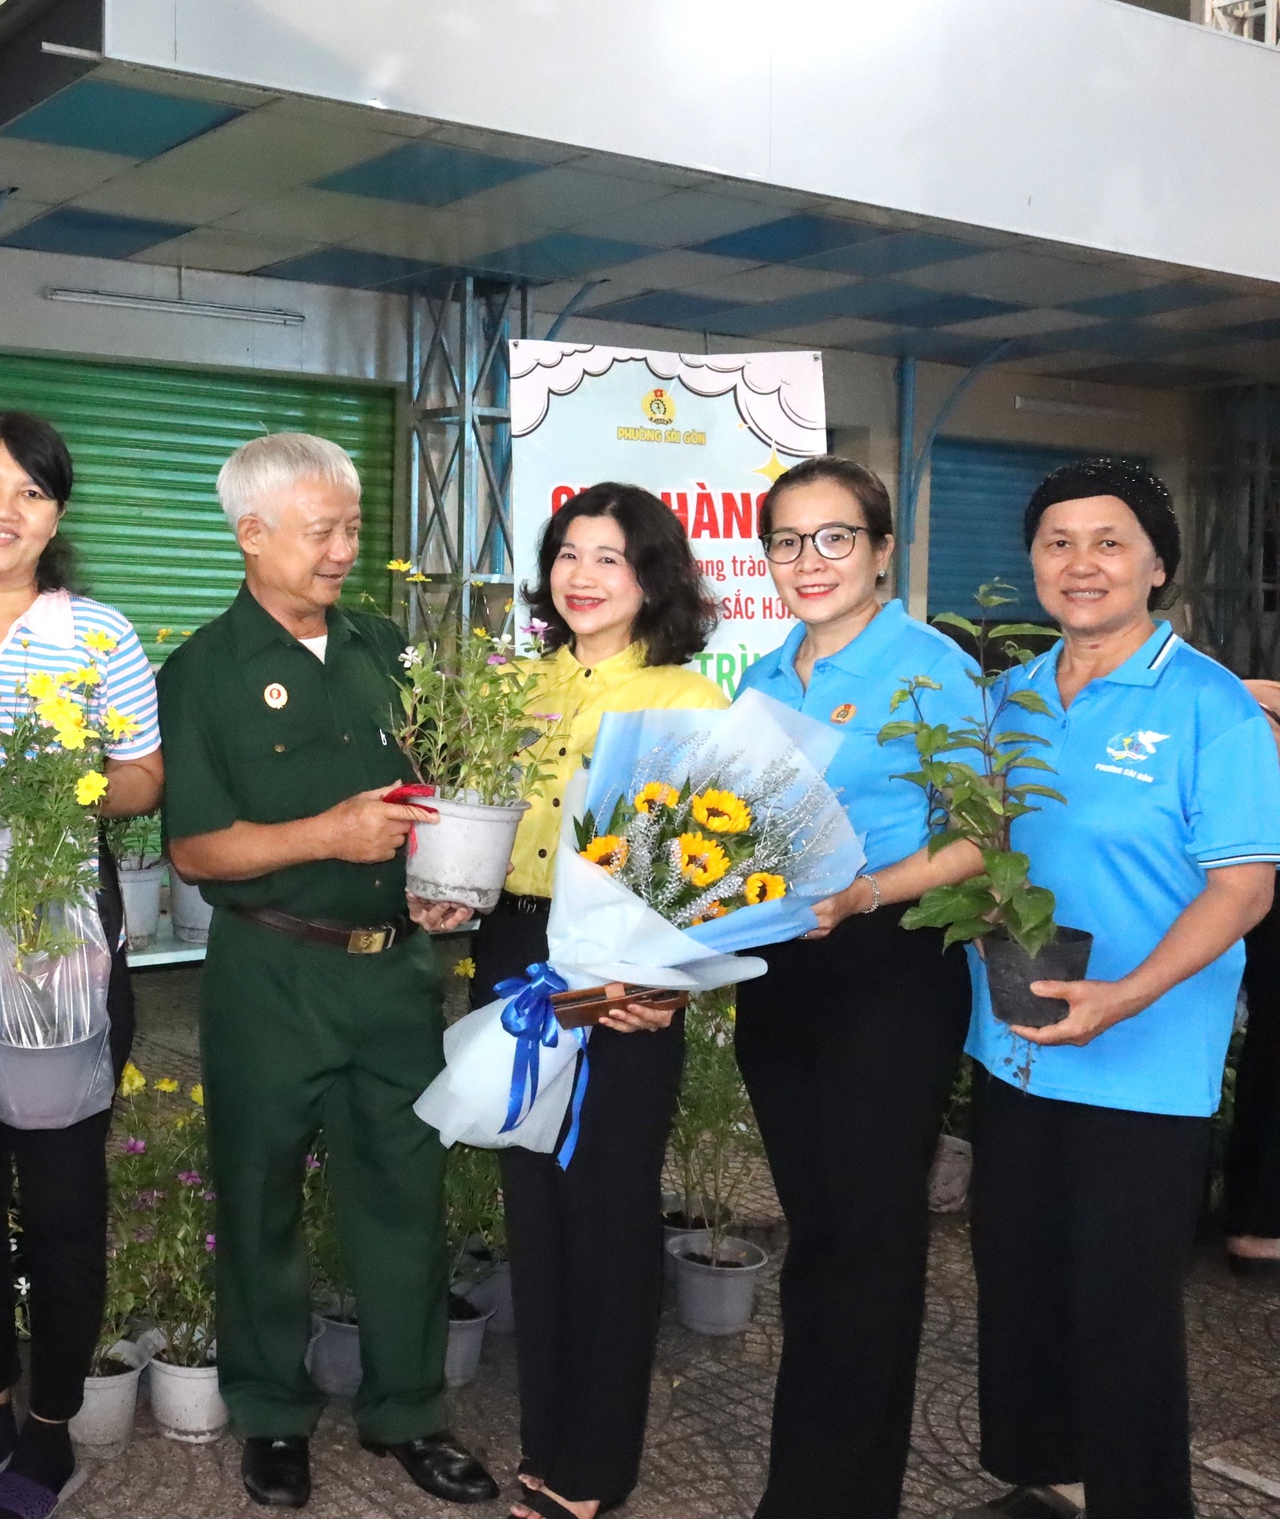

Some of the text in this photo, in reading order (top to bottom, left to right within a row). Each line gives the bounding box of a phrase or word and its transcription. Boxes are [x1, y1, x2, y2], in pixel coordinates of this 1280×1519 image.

[664, 428, 681, 444] SÀI
[683, 429, 707, 445] GÒN
[731, 555, 766, 577] trào
[722, 589, 755, 620] SẮC
[694, 644, 761, 699] TRÌ
